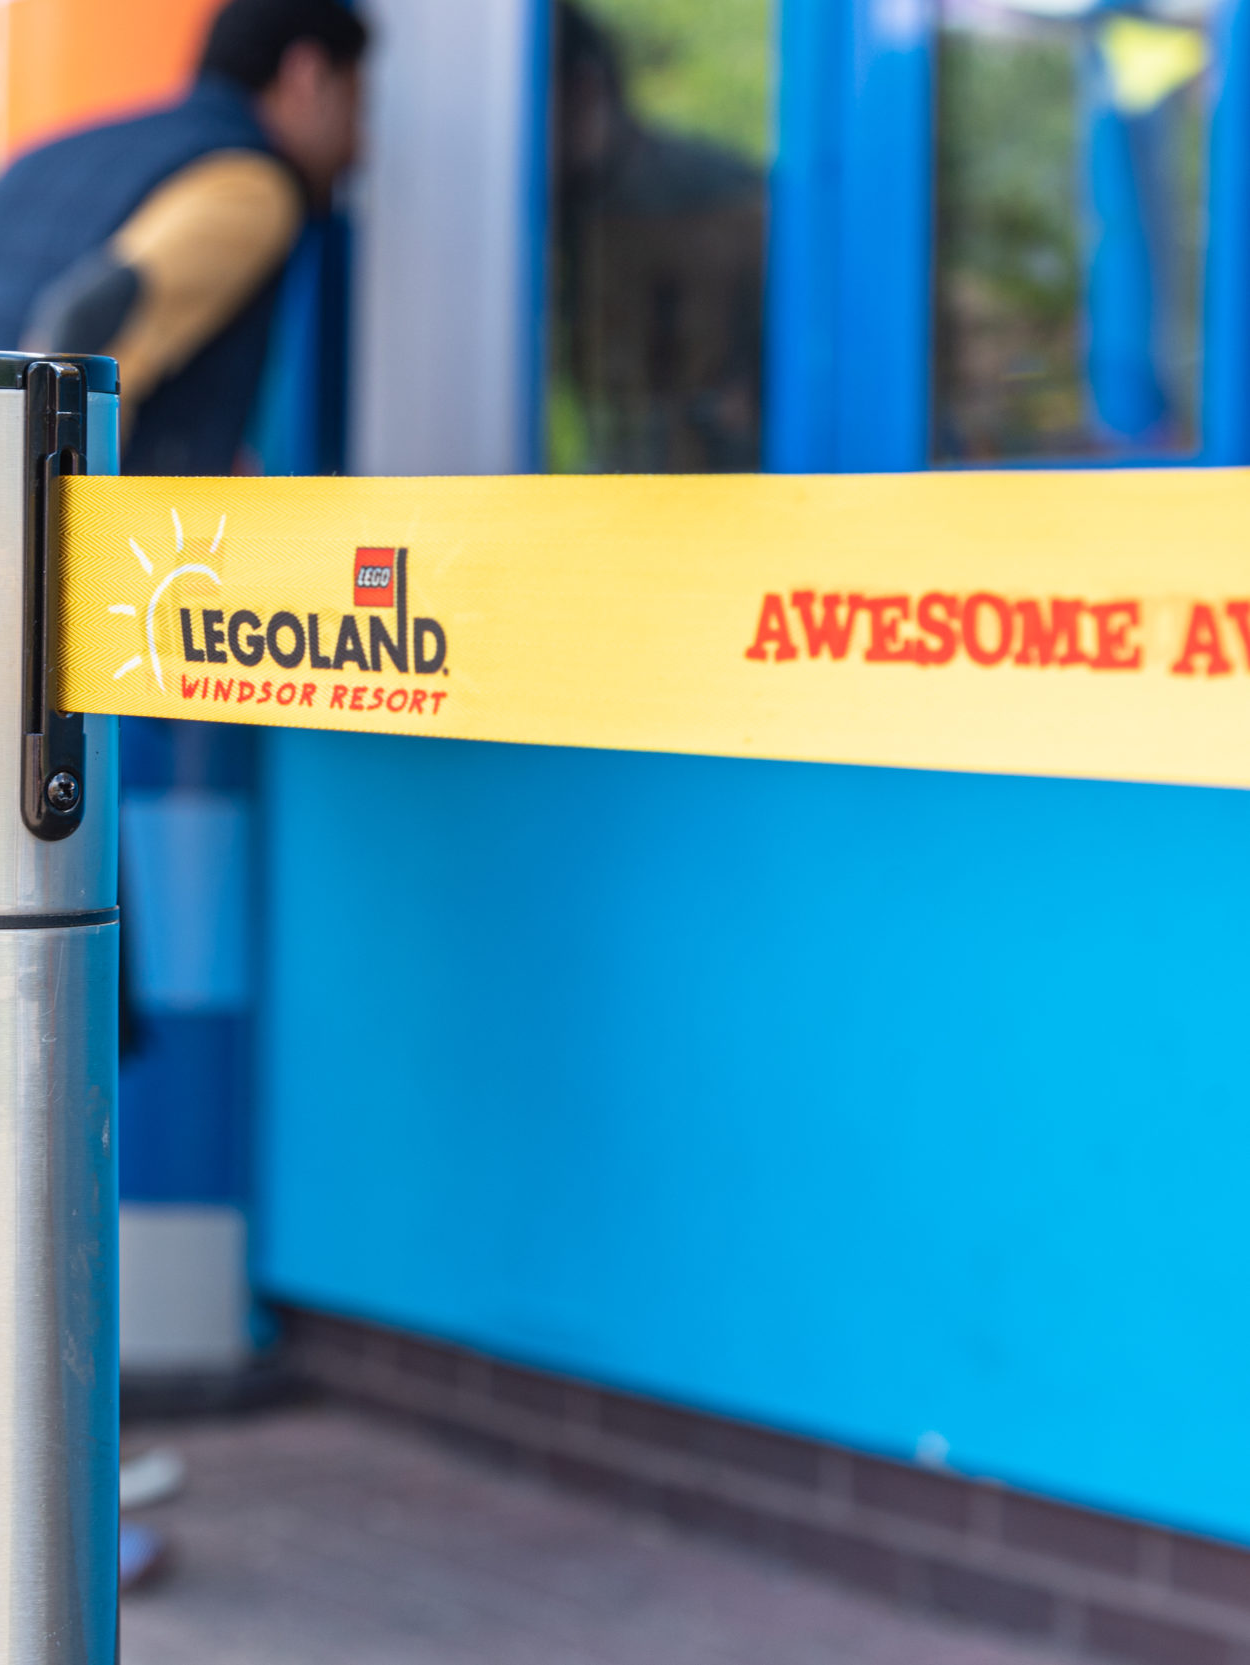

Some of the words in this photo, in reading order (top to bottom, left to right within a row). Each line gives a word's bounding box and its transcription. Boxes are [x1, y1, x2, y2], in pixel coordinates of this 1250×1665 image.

[357, 565, 392, 588] LEGO
[745, 590, 1141, 670] AWESOME
[182, 674, 317, 707] WINDSOR
[330, 685, 448, 715] RESORT
